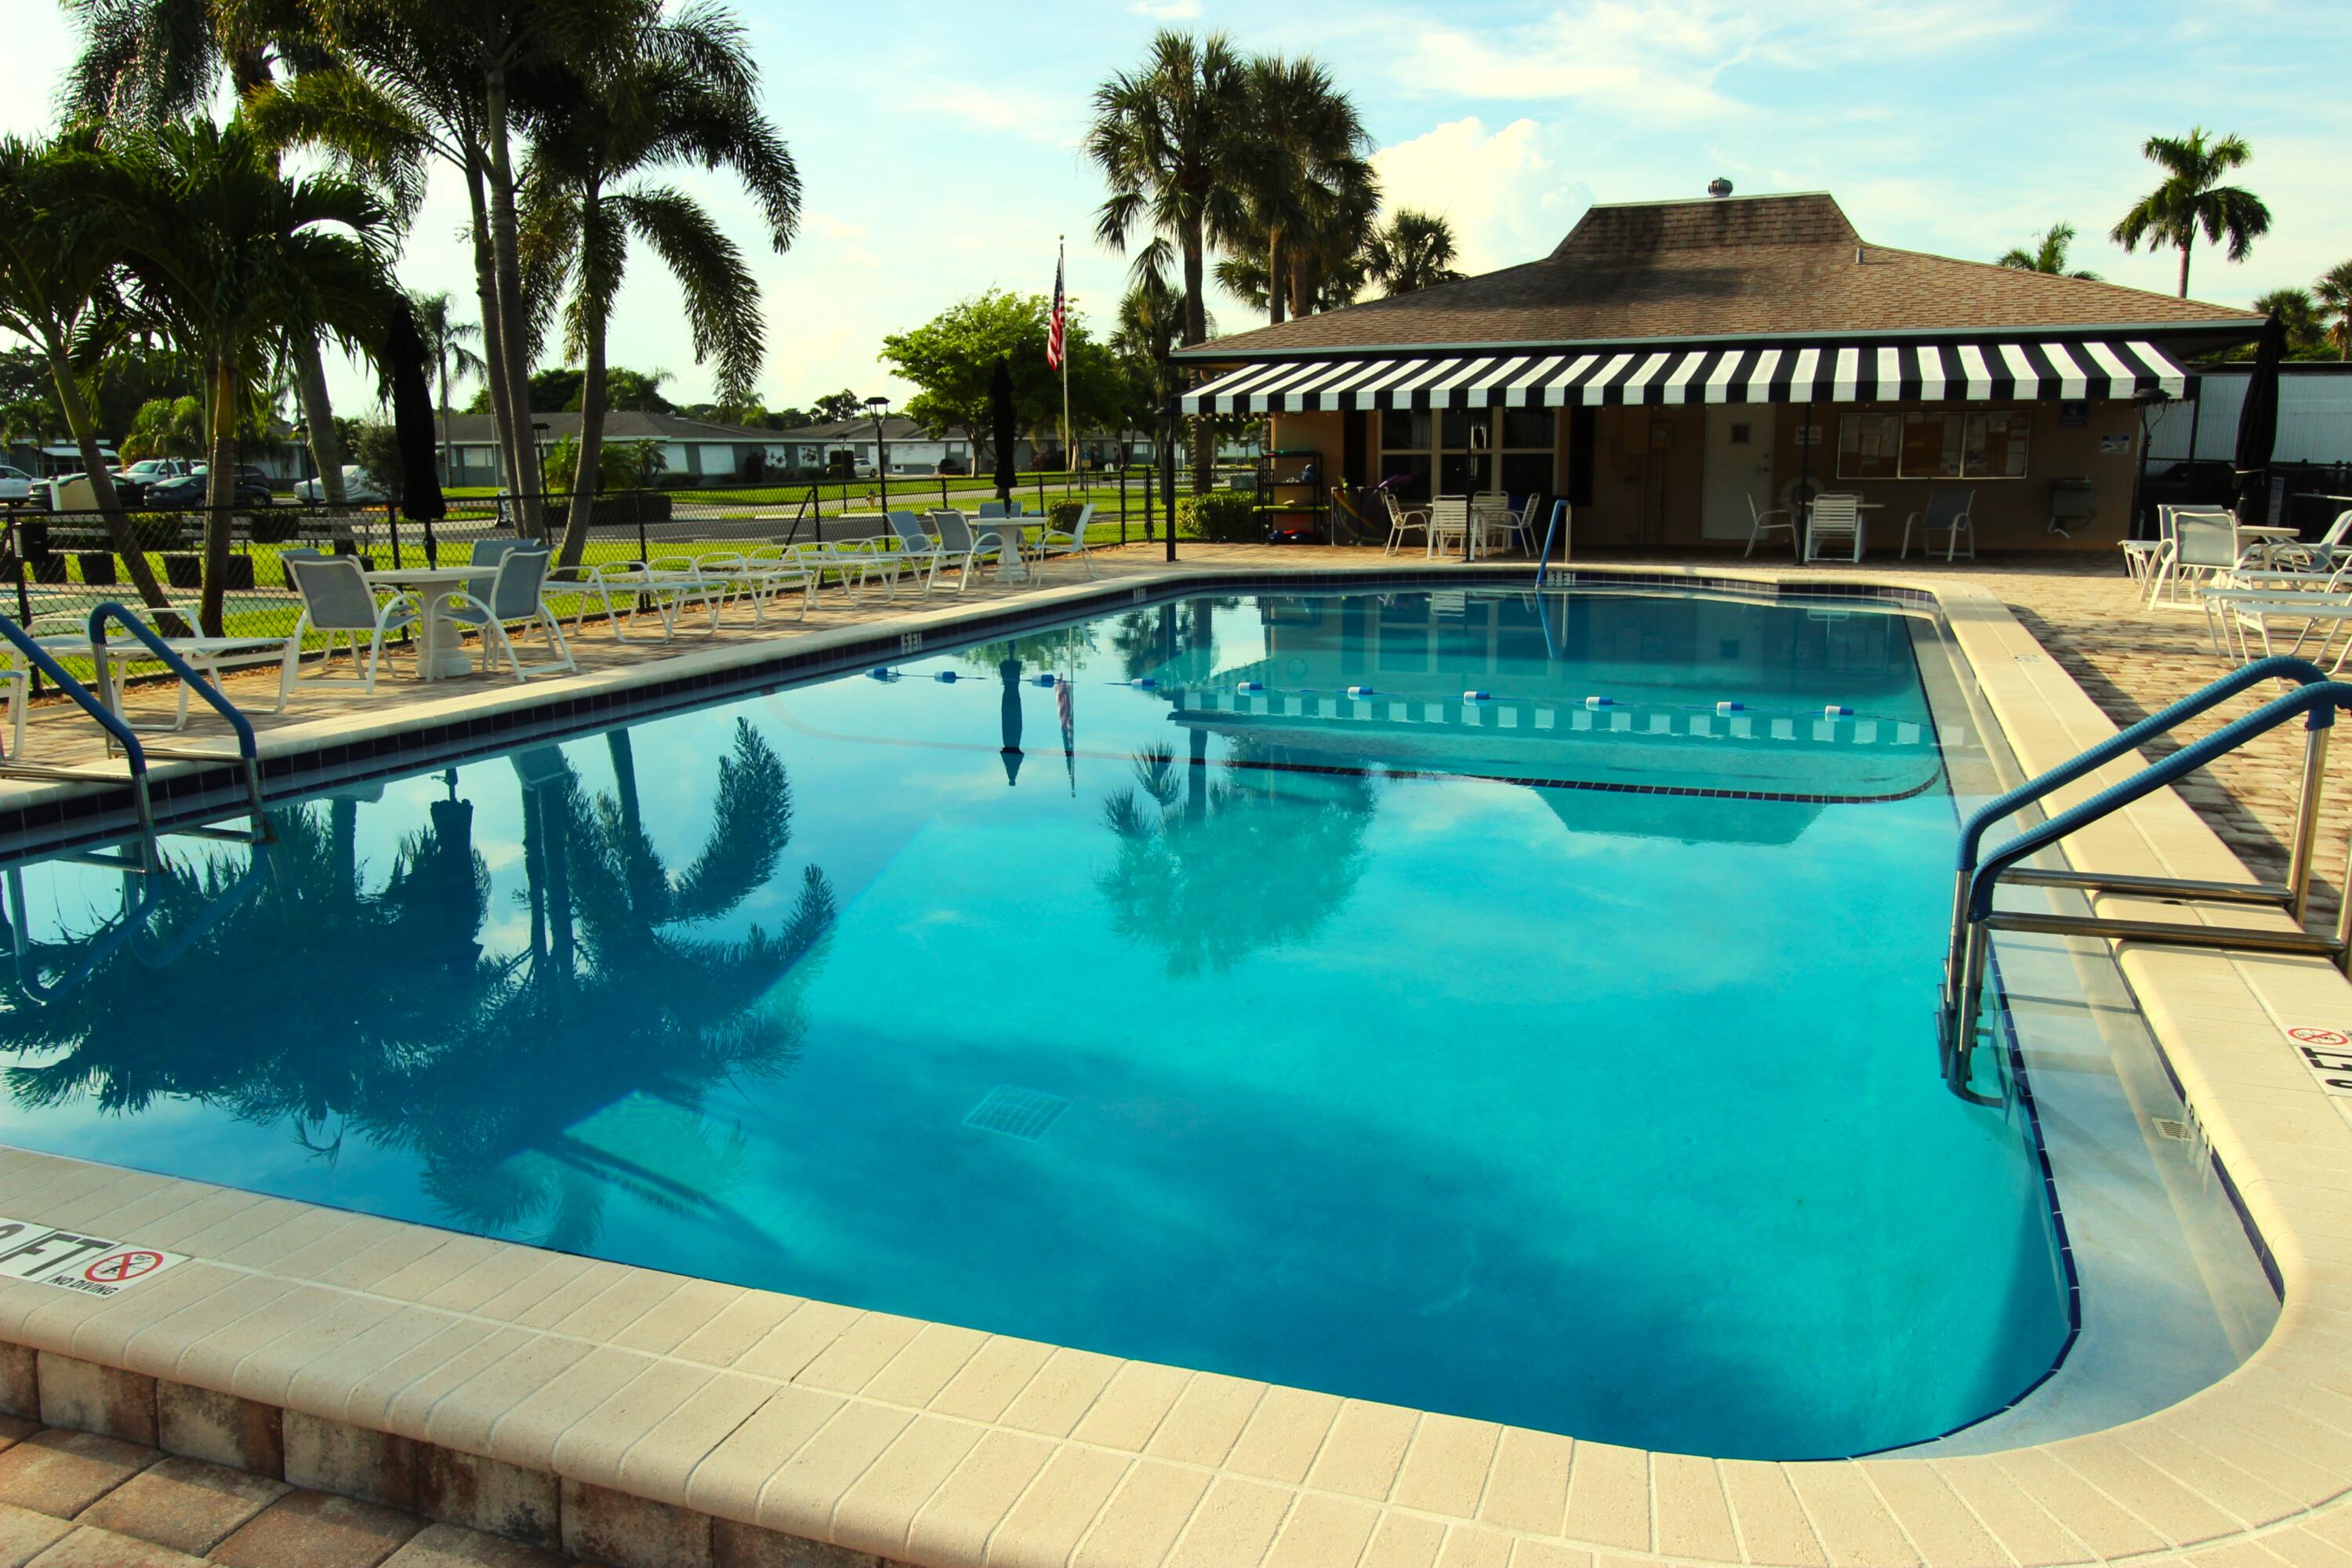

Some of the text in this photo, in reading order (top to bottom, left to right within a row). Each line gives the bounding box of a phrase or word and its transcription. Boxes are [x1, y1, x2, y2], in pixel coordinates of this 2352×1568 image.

[1563, 571, 1575, 581] FT
[0, 1232, 115, 1276] FT
[49, 1276, 118, 1295] NO DIVING
